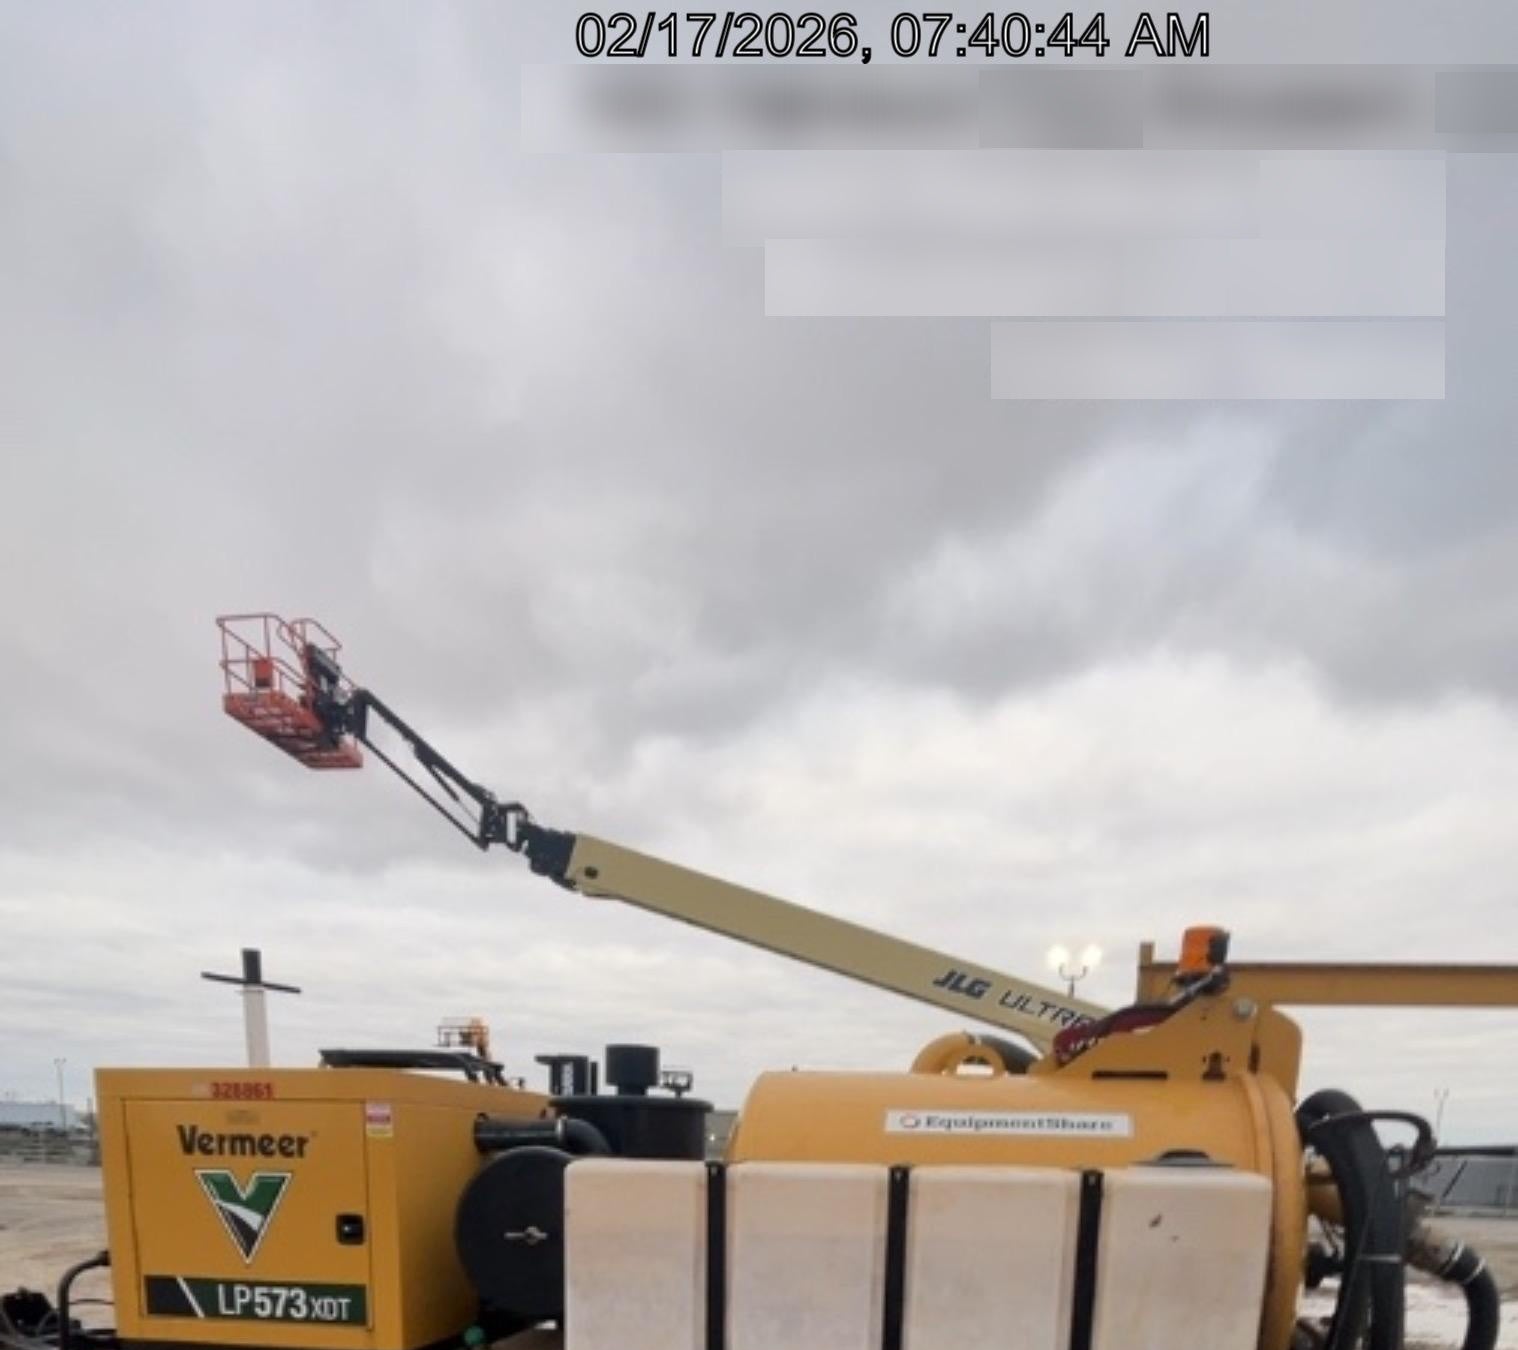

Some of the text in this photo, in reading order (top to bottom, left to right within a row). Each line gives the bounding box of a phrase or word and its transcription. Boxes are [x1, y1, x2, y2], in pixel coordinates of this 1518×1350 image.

[932, 970, 992, 999] JLG
[925, 1115, 1114, 1131] EquipmentShare
[176, 1124, 310, 1158] Vermeer
